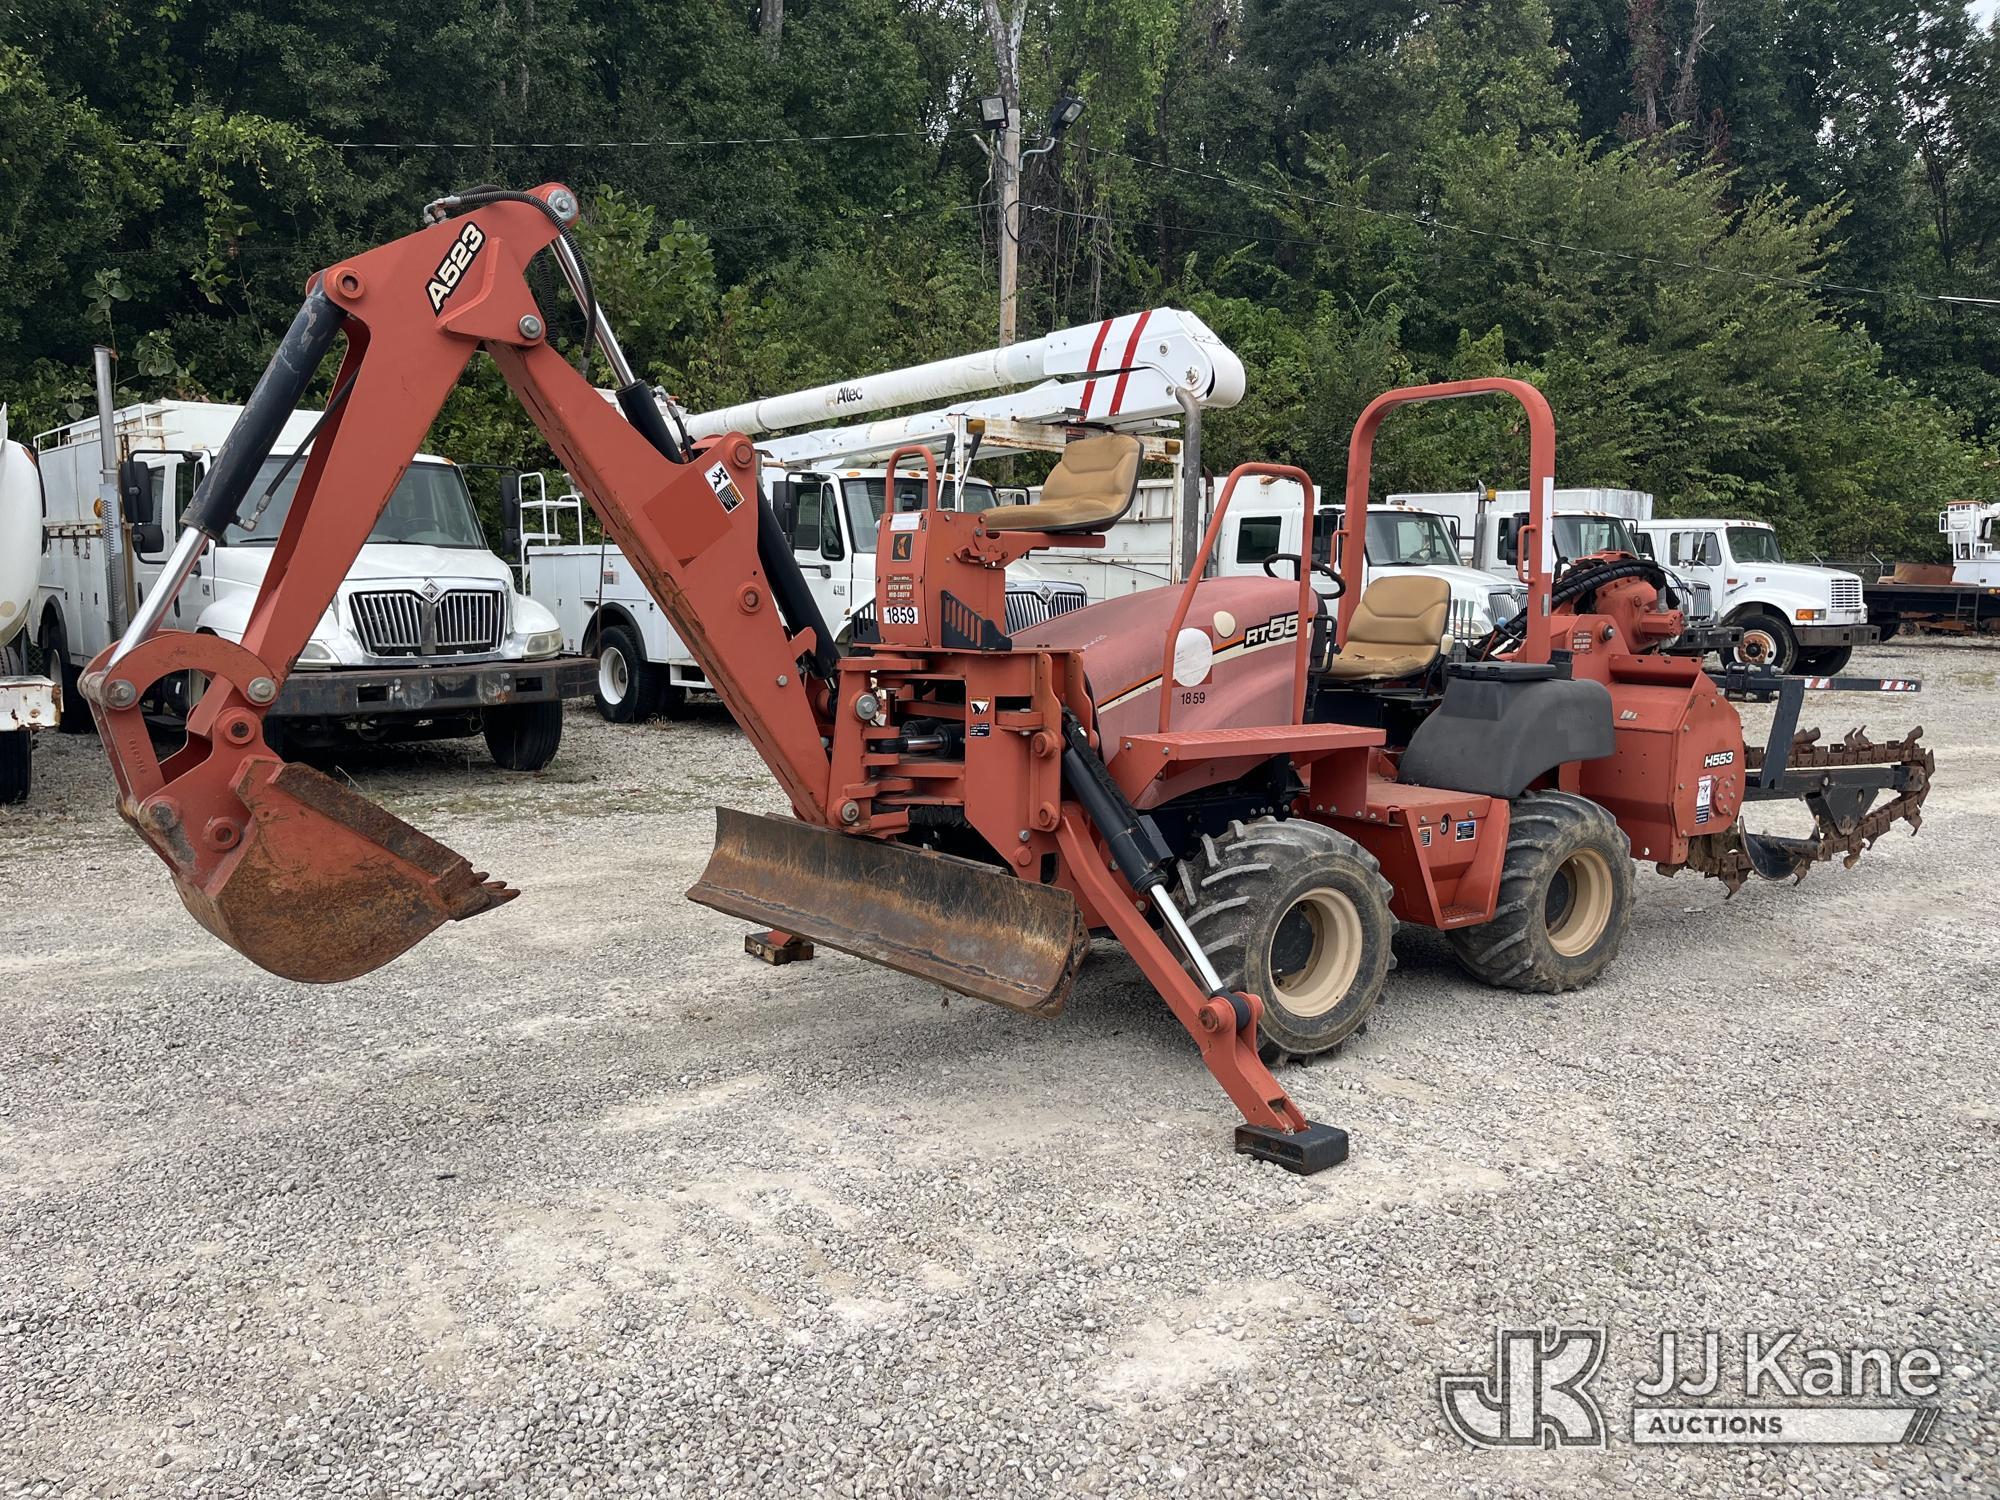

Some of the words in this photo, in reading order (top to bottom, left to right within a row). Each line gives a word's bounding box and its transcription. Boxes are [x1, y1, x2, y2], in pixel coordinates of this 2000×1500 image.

[428, 223, 483, 310] A523
[836, 386, 863, 405] Altec
[886, 606, 915, 624] 1859
[1245, 613, 1299, 645] RT55
[1180, 691, 1206, 705] 1859
[1704, 751, 1734, 768] H553
